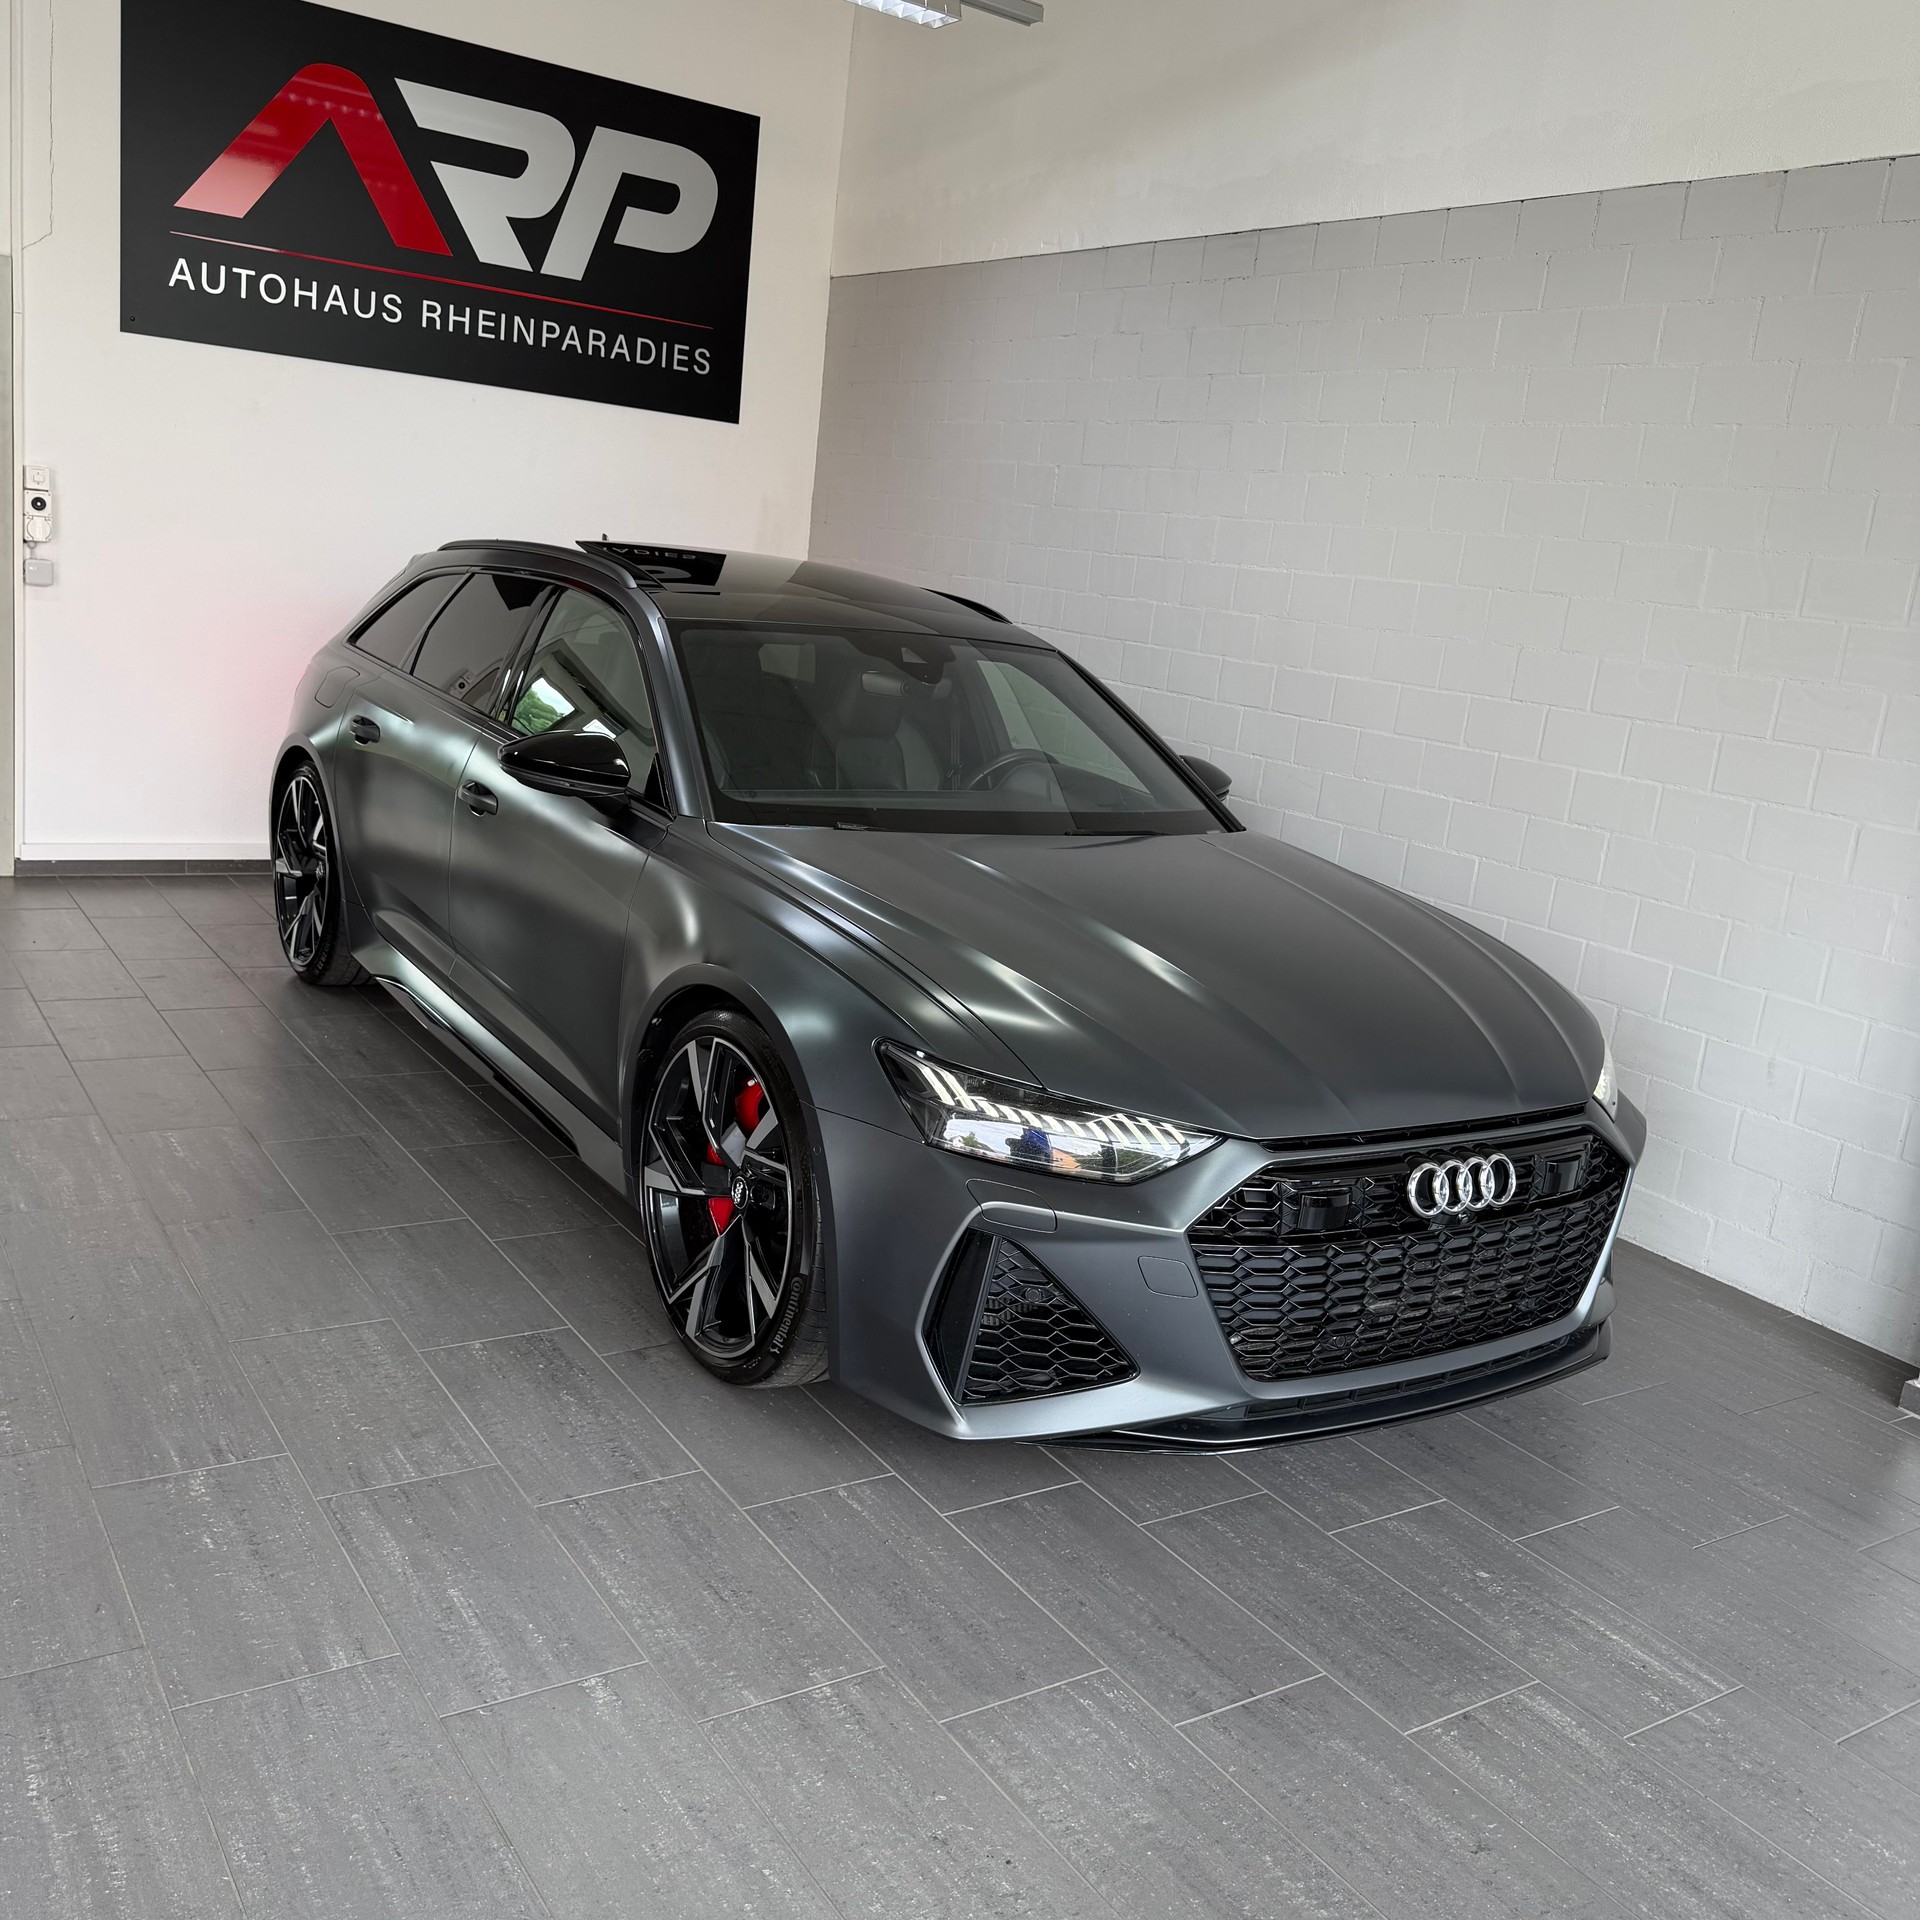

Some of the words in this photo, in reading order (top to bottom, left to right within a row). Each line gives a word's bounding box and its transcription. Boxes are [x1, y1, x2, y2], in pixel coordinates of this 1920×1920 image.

[173, 62, 719, 281] ARP
[168, 257, 403, 324] AUTOHAUS
[421, 299, 711, 375] RHEINPARADIES
[772, 1276, 804, 1349] Continental
